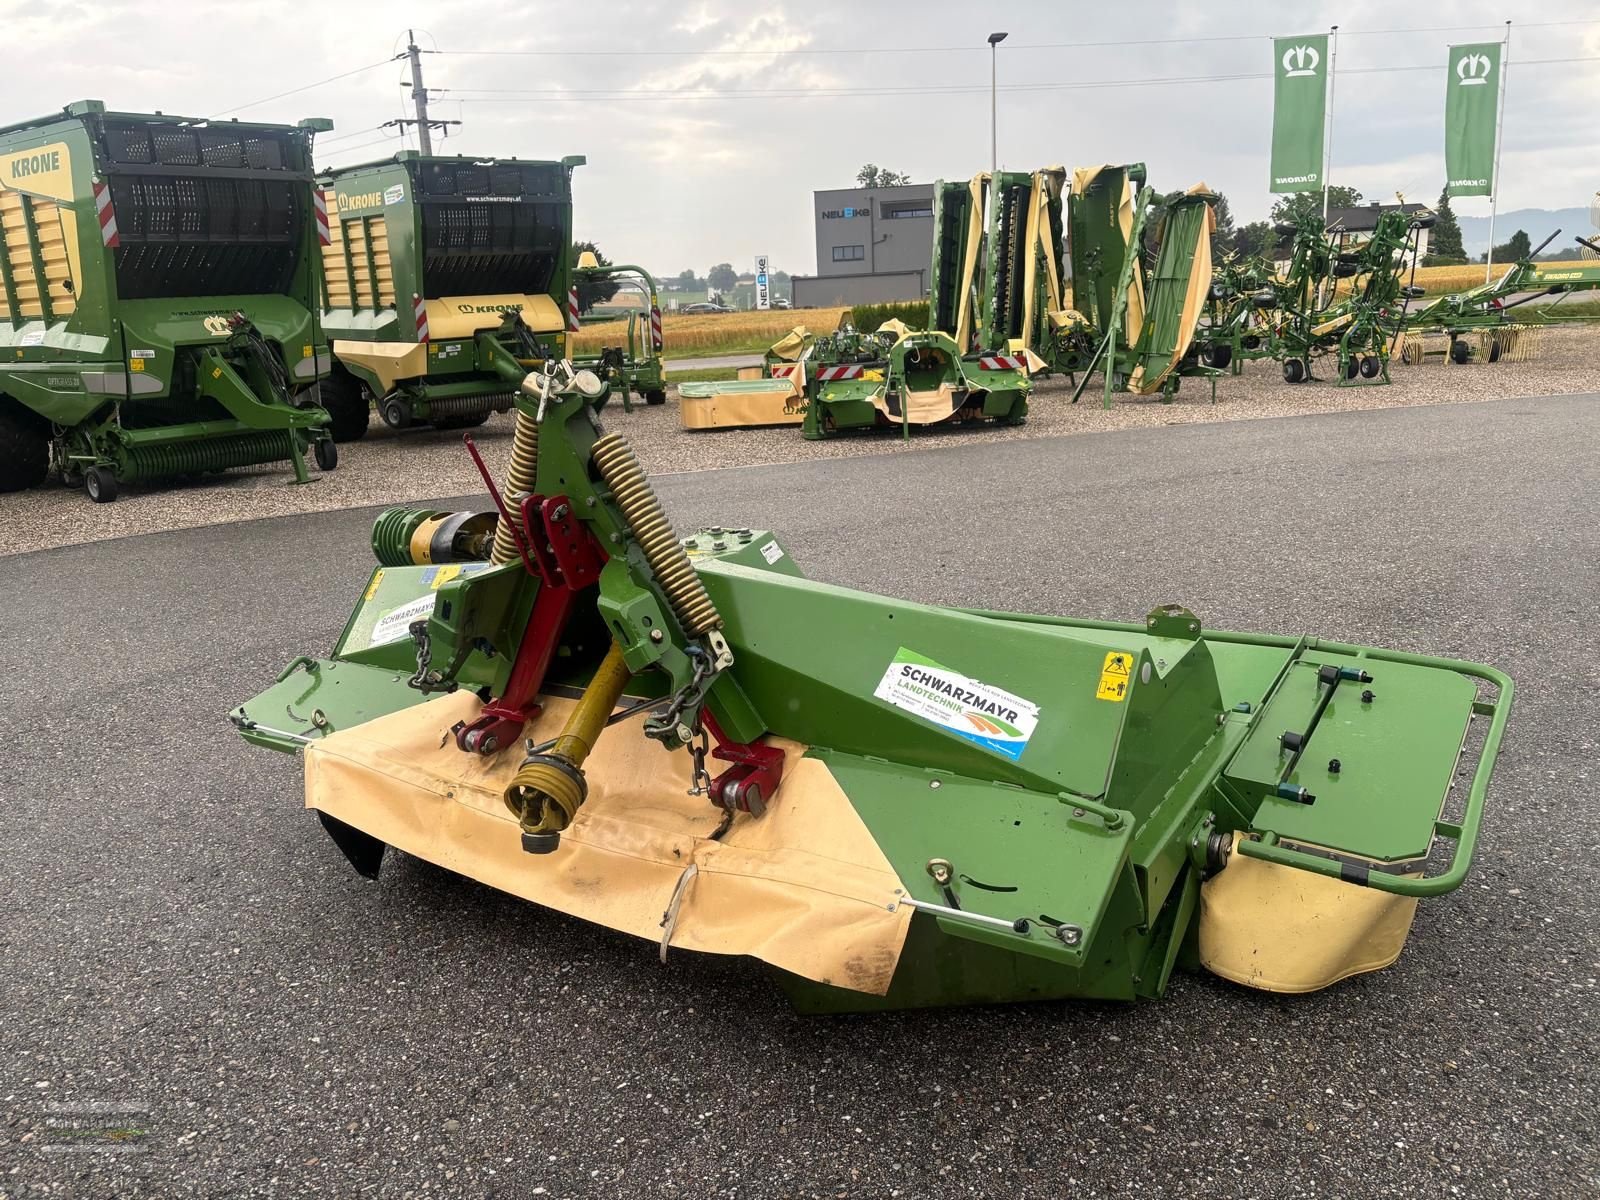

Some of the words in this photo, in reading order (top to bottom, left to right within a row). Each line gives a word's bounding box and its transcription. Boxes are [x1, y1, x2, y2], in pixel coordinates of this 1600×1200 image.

[12, 151, 59, 178] KRONE
[349, 192, 381, 210] KRONE
[380, 602, 435, 626] SCHWARZMAYR
[896, 678, 964, 713] LANDTECHNIK
[900, 664, 1018, 724] SCHWARZMAYR
